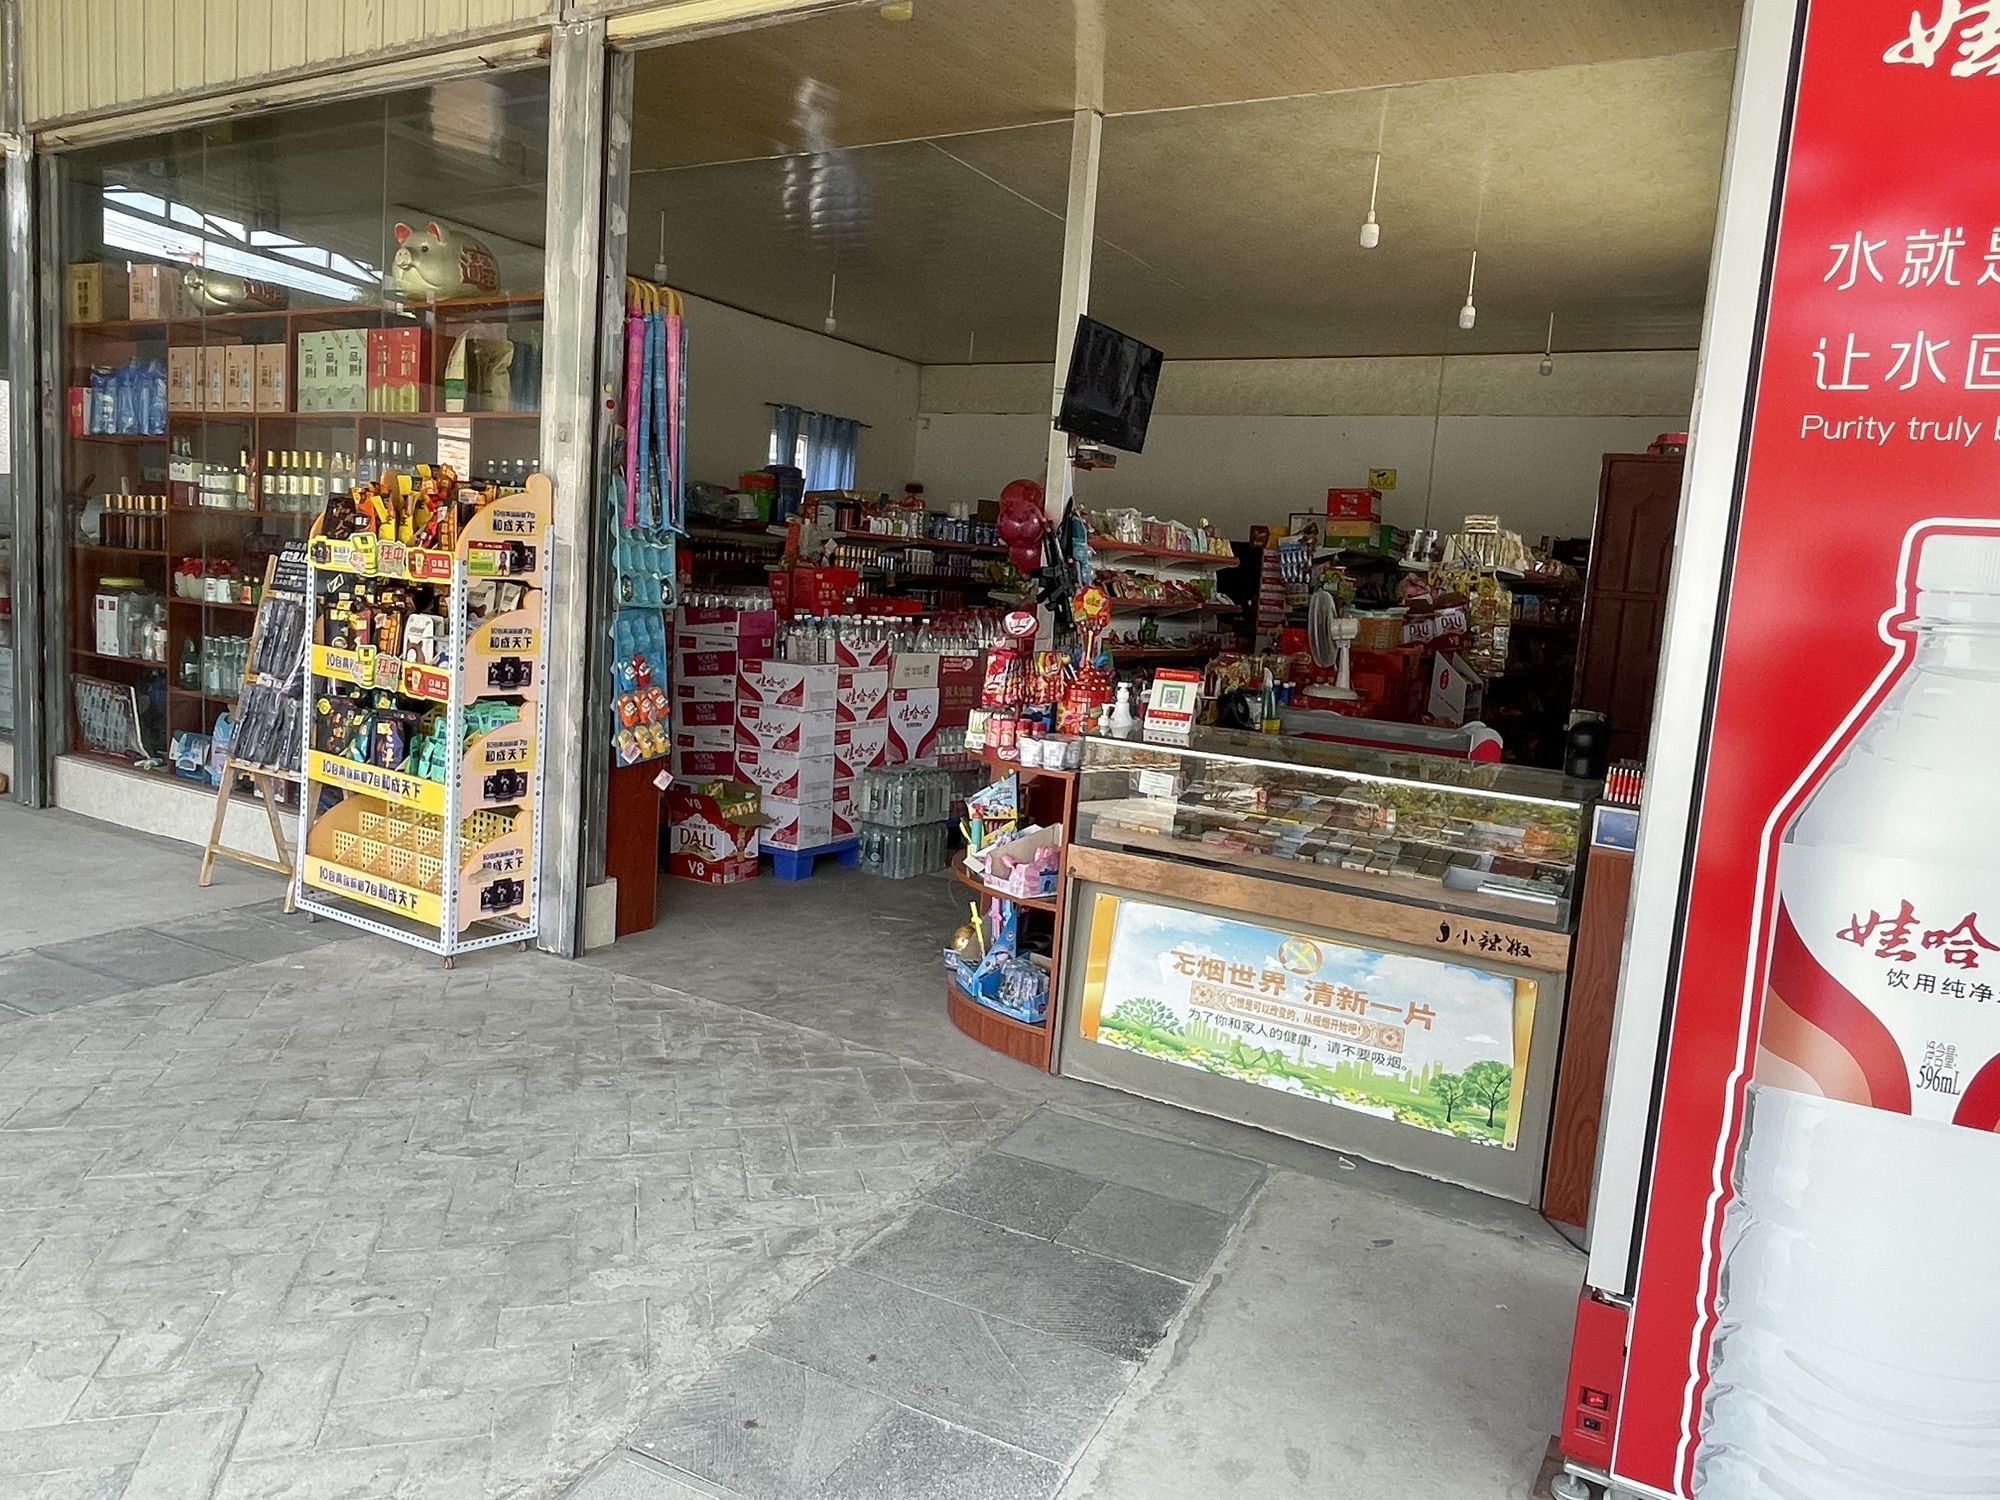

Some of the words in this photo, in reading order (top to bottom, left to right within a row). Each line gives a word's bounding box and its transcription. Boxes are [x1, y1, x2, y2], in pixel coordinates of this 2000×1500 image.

[1801, 414, 1895, 446] Purity
[1907, 415, 1982, 447] truly
[493, 519, 536, 534] 和成天下
[490, 636, 533, 649] 和成天下
[756, 674, 789, 689] 娃哈哈
[845, 688, 880, 705] 娃哈哈
[898, 703, 931, 721] 娃哈哈
[753, 720, 785, 735] 娃哈哈
[485, 748, 528, 763] 和成天下
[751, 765, 784, 780] 娃哈哈
[684, 797, 702, 810] V8
[680, 828, 716, 850] DALI
[687, 860, 705, 876] V8
[1456, 929, 1532, 958] 小辣椒
[1170, 948, 1287, 996] 无烟世界
[1303, 979, 1437, 1032] 清新一片
[1886, 968, 2000, 1004] 饮用纯净
[1915, 1065, 1961, 1096] 596mL
